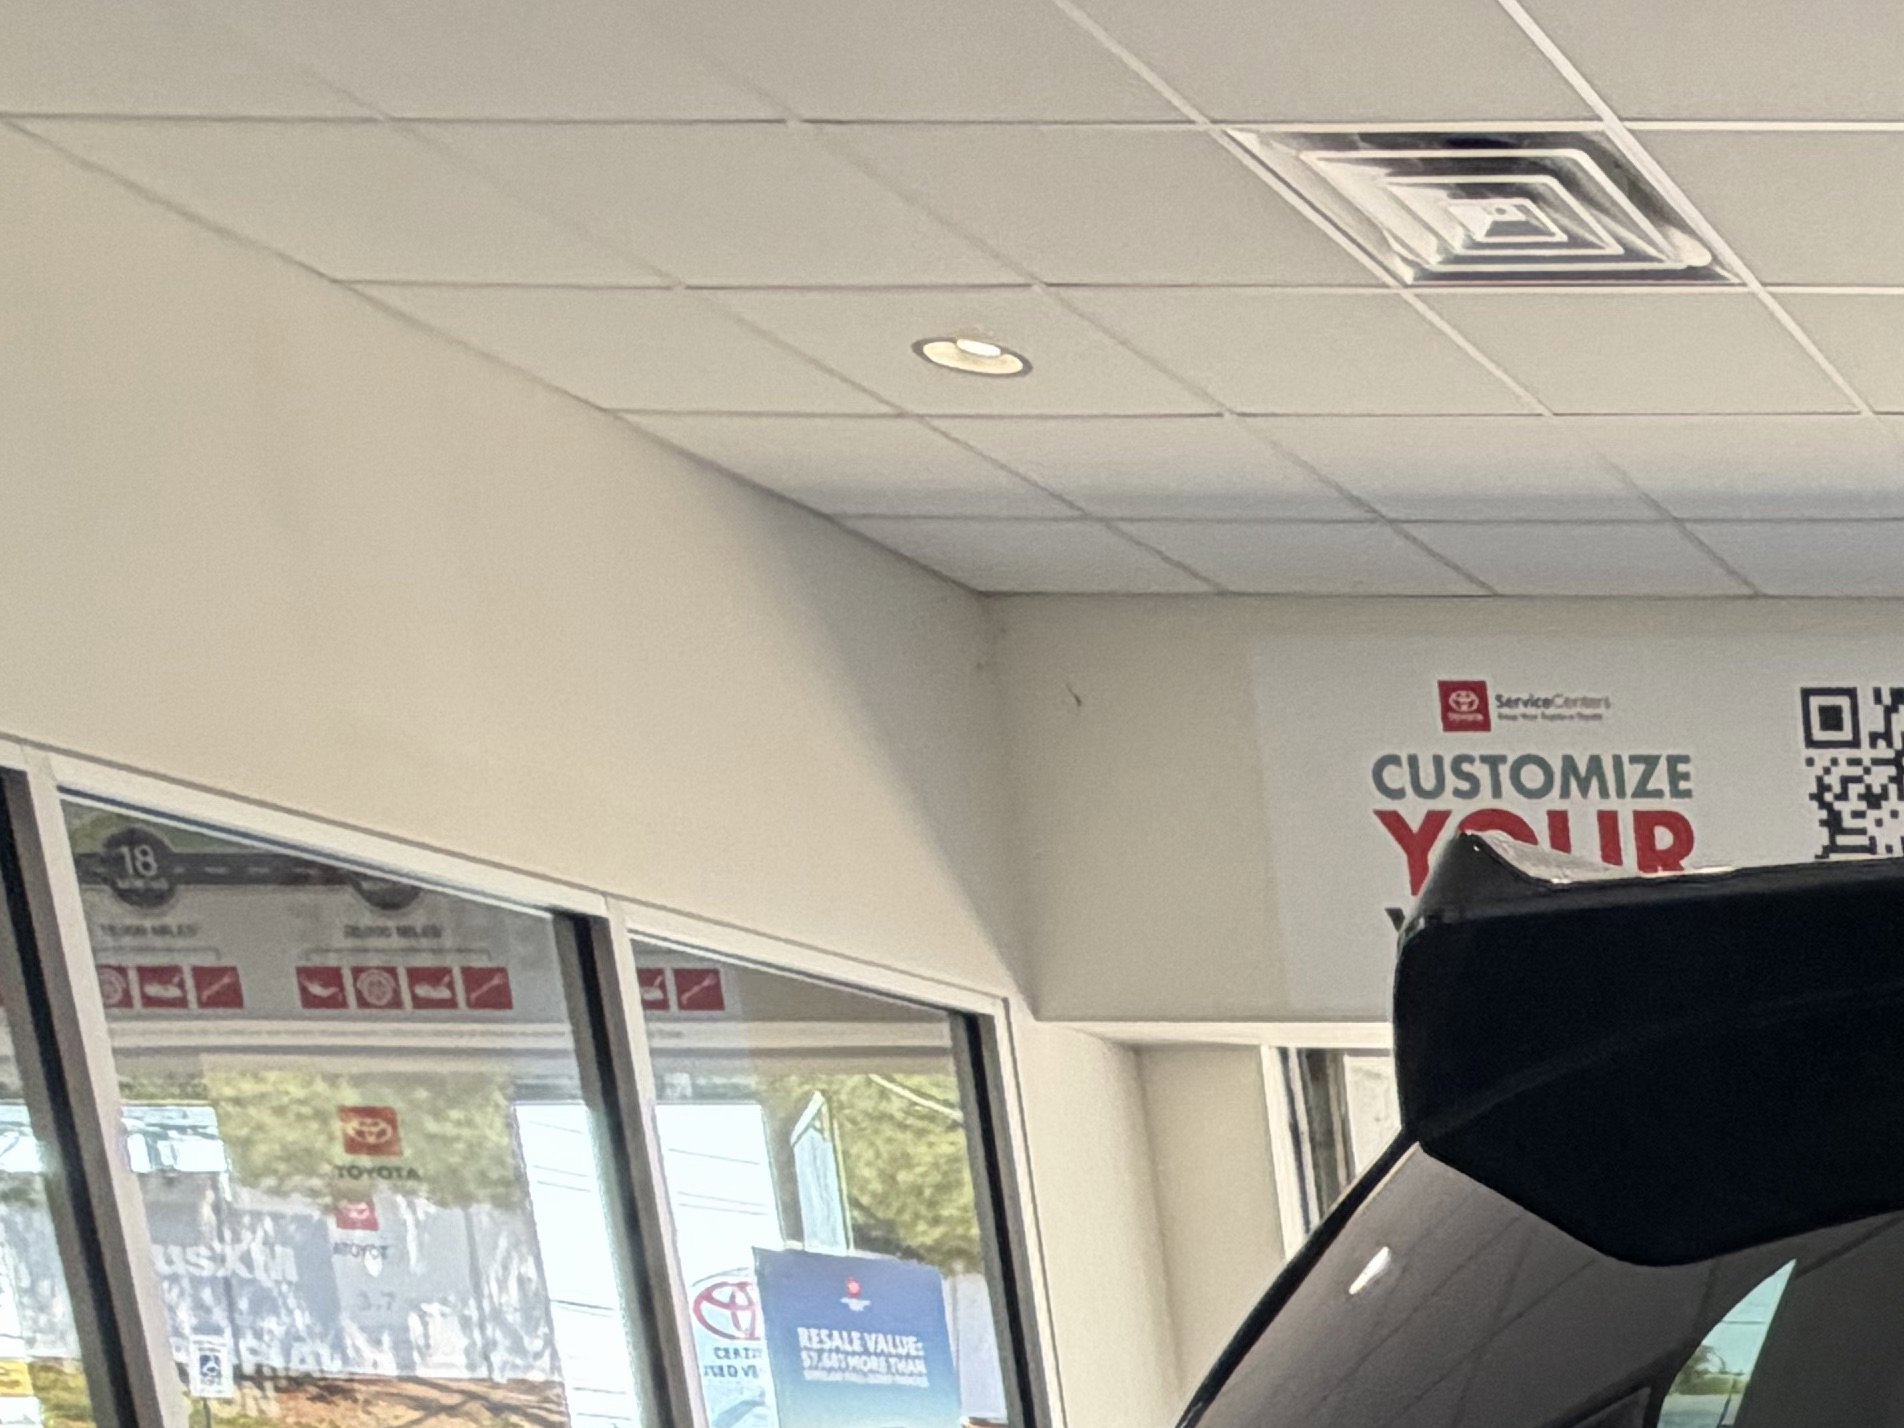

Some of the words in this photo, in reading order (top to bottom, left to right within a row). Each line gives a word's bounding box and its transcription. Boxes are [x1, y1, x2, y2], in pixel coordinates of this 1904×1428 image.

[1372, 753, 1694, 801] CUSTOMIZE
[118, 845, 160, 878] 18
[334, 1165, 421, 1180] TOYOTA
[797, 1326, 863, 1353] RESALE
